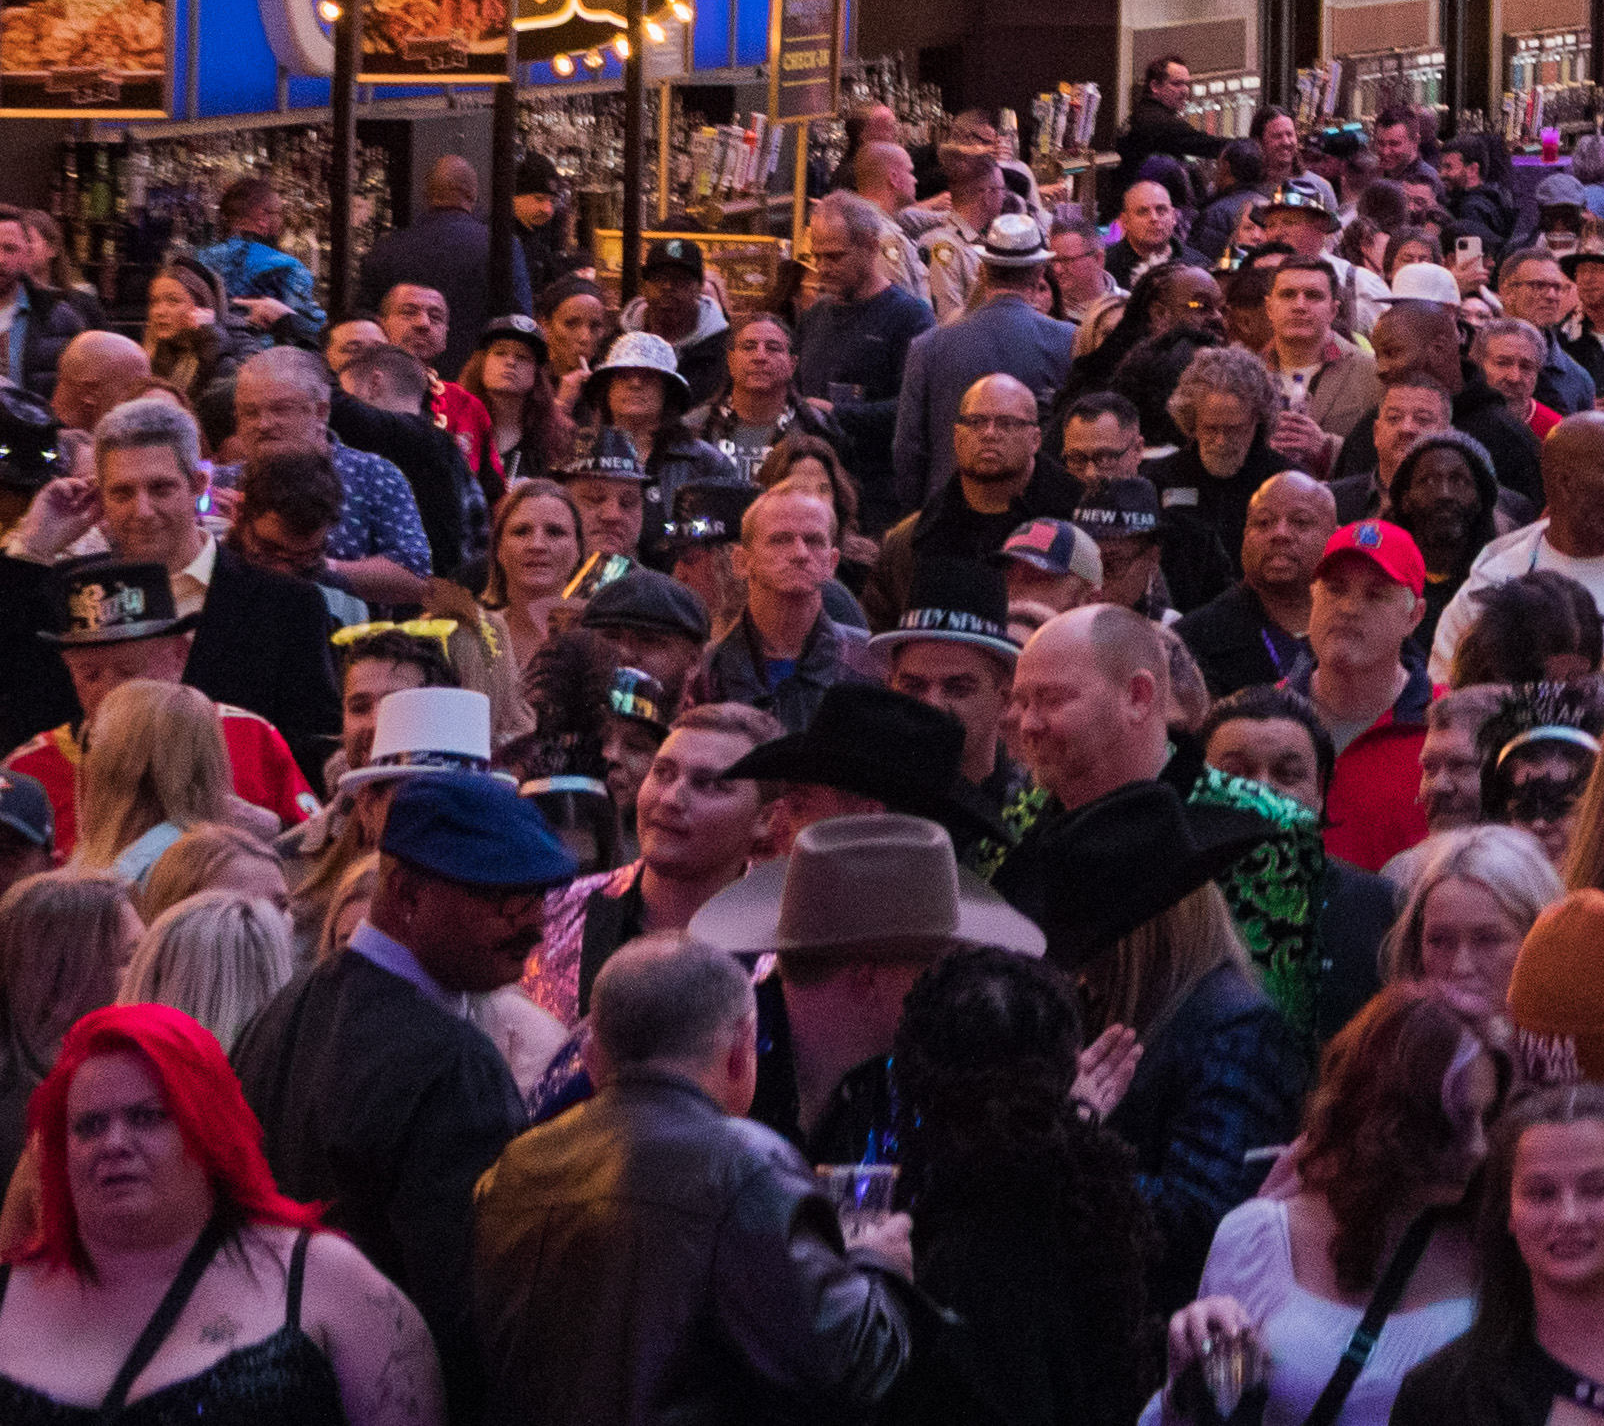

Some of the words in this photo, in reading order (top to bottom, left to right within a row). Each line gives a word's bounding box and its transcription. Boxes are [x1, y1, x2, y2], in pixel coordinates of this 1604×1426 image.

[599, 456, 635, 471] NEW
[1082, 509, 1116, 525] NEW
[1121, 511, 1157, 529] YEAR
